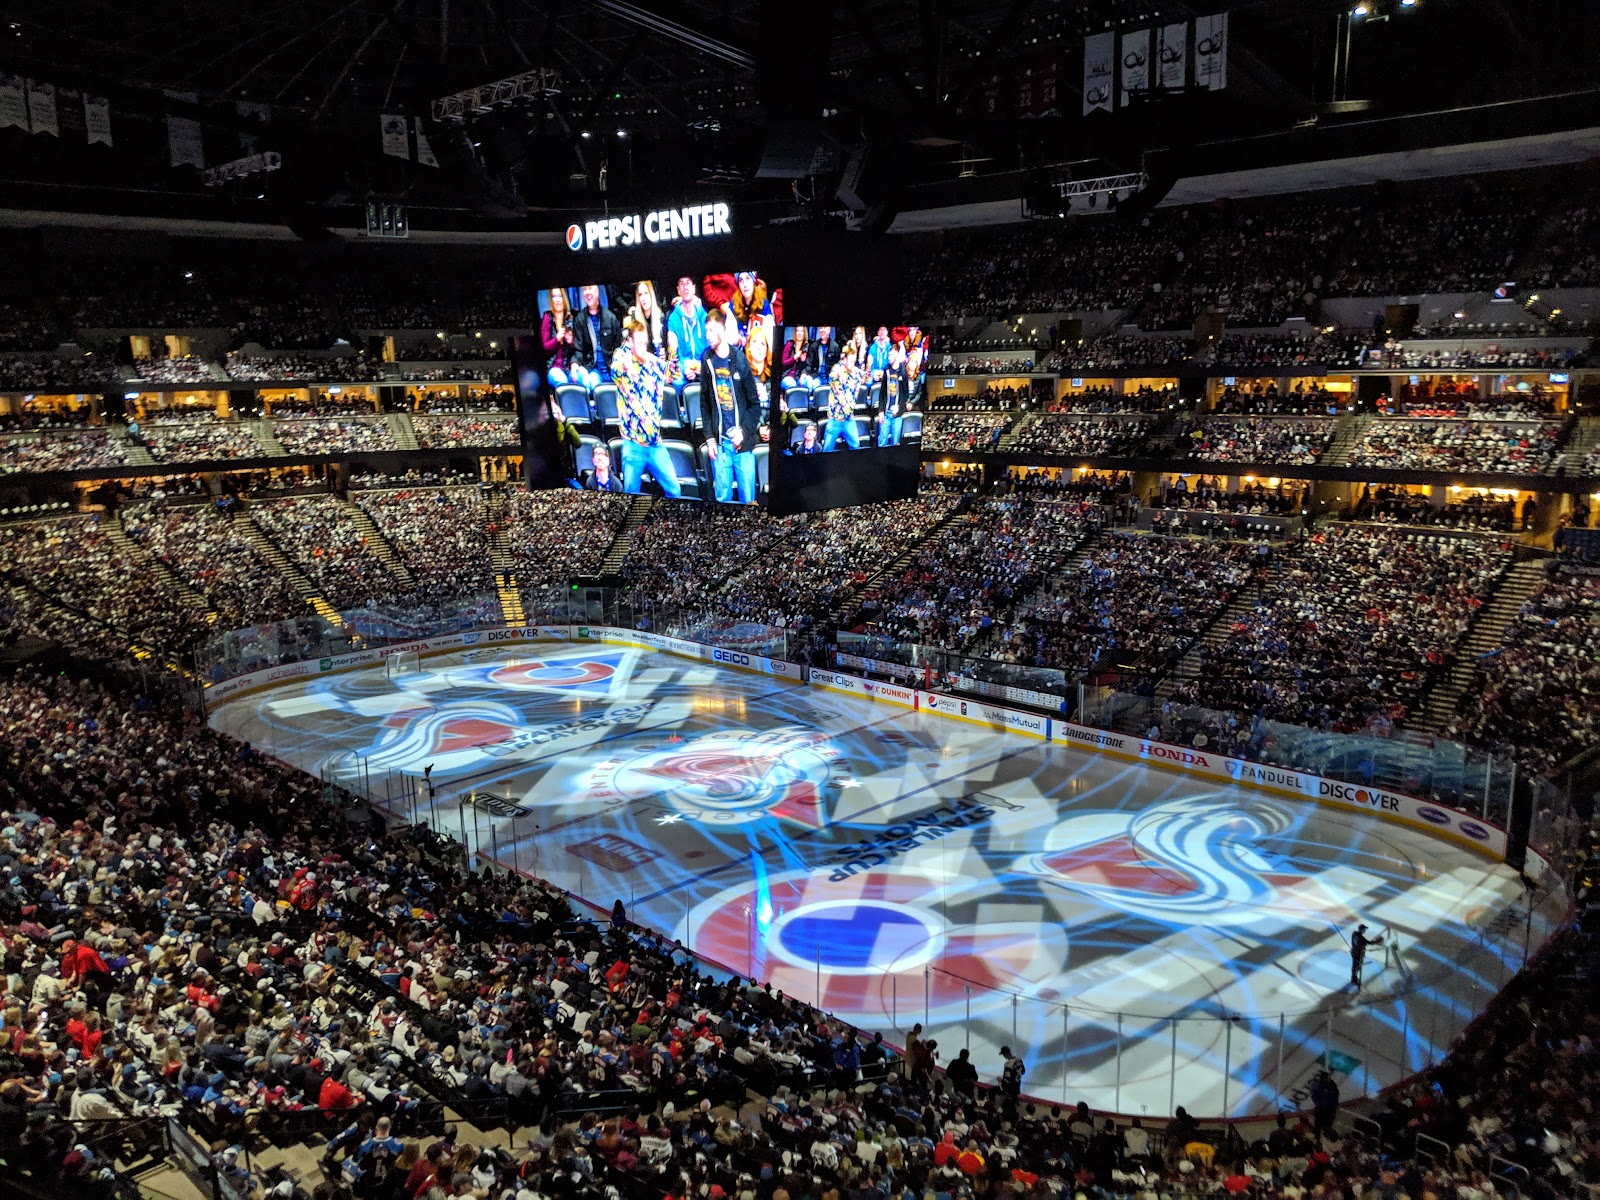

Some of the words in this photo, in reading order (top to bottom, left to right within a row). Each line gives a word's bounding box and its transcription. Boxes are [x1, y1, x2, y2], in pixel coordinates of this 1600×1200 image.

[585, 214, 642, 250] PEPSI
[644, 202, 732, 243] CENTER
[488, 628, 539, 641] DISCOVER
[579, 626, 624, 639] enterprise
[379, 643, 430, 658] HONDA
[713, 649, 750, 666] GEICO
[320, 654, 373, 671] enterprise
[267, 664, 309, 680] uchealth
[811, 670, 834, 684] Great
[835, 675, 854, 688] Clips
[881, 687, 912, 700] DUNKIN'
[609, 702, 656, 717] CUP
[938, 698, 957, 708] pepsi
[991, 711, 1041, 730] MassMutual
[513, 713, 643, 750] PLAYOFFS
[1061, 726, 1126, 749] BRIDGESTONE
[1139, 743, 1210, 768] HONDA
[1241, 766, 1303, 789] FANDUEL
[1319, 781, 1400, 812] DISCOVER
[837, 799, 978, 859] PLAYOFFS
[889, 805, 997, 858] STANLEY
[828, 852, 887, 883] CUP
